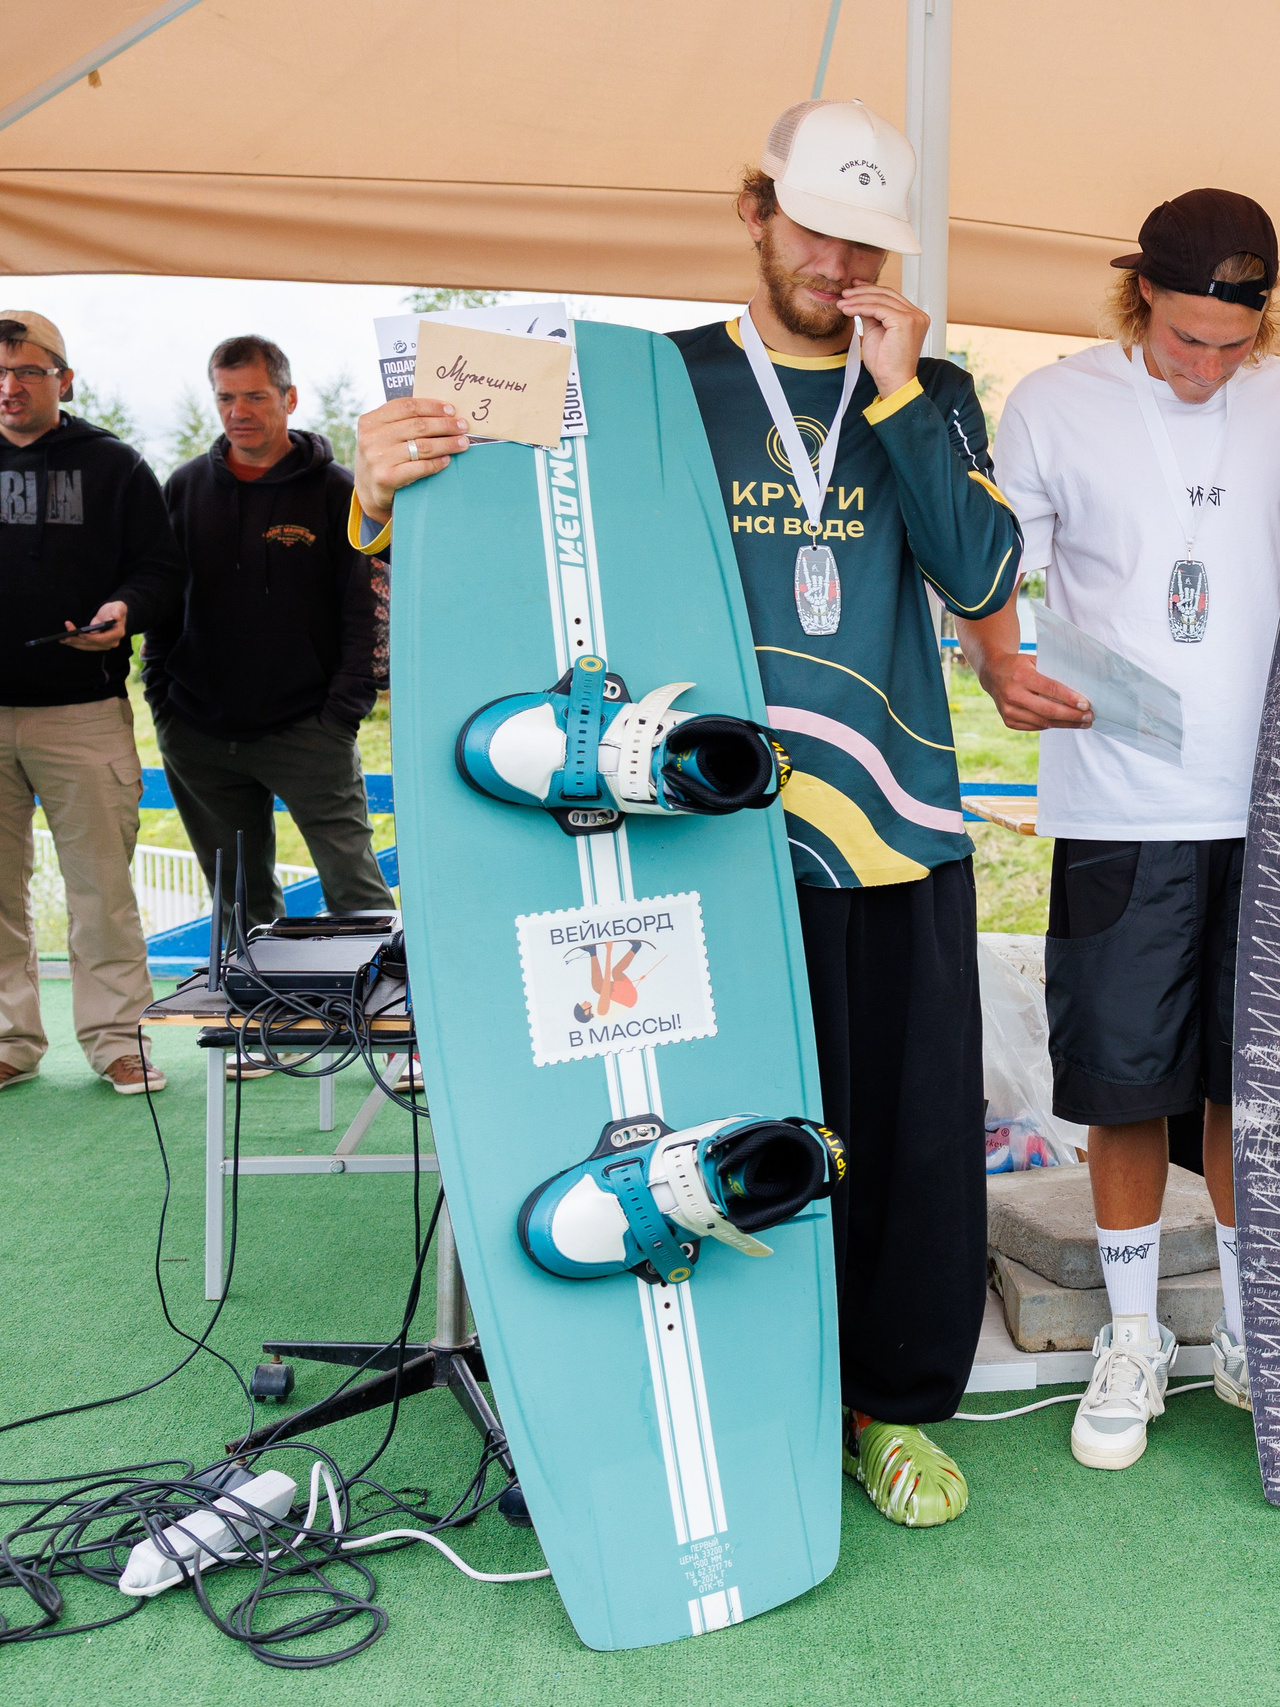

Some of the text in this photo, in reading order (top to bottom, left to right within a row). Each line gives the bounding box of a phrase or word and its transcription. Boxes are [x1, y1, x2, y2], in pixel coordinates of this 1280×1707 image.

[386, 375, 416, 389] СЕРТИ
[436, 355, 527, 391] Мужчины
[733, 515, 865, 541] на воде
[550, 912, 674, 945] ВЕЙКБОРД
[569, 1013, 682, 1047] В МАССЫ!
